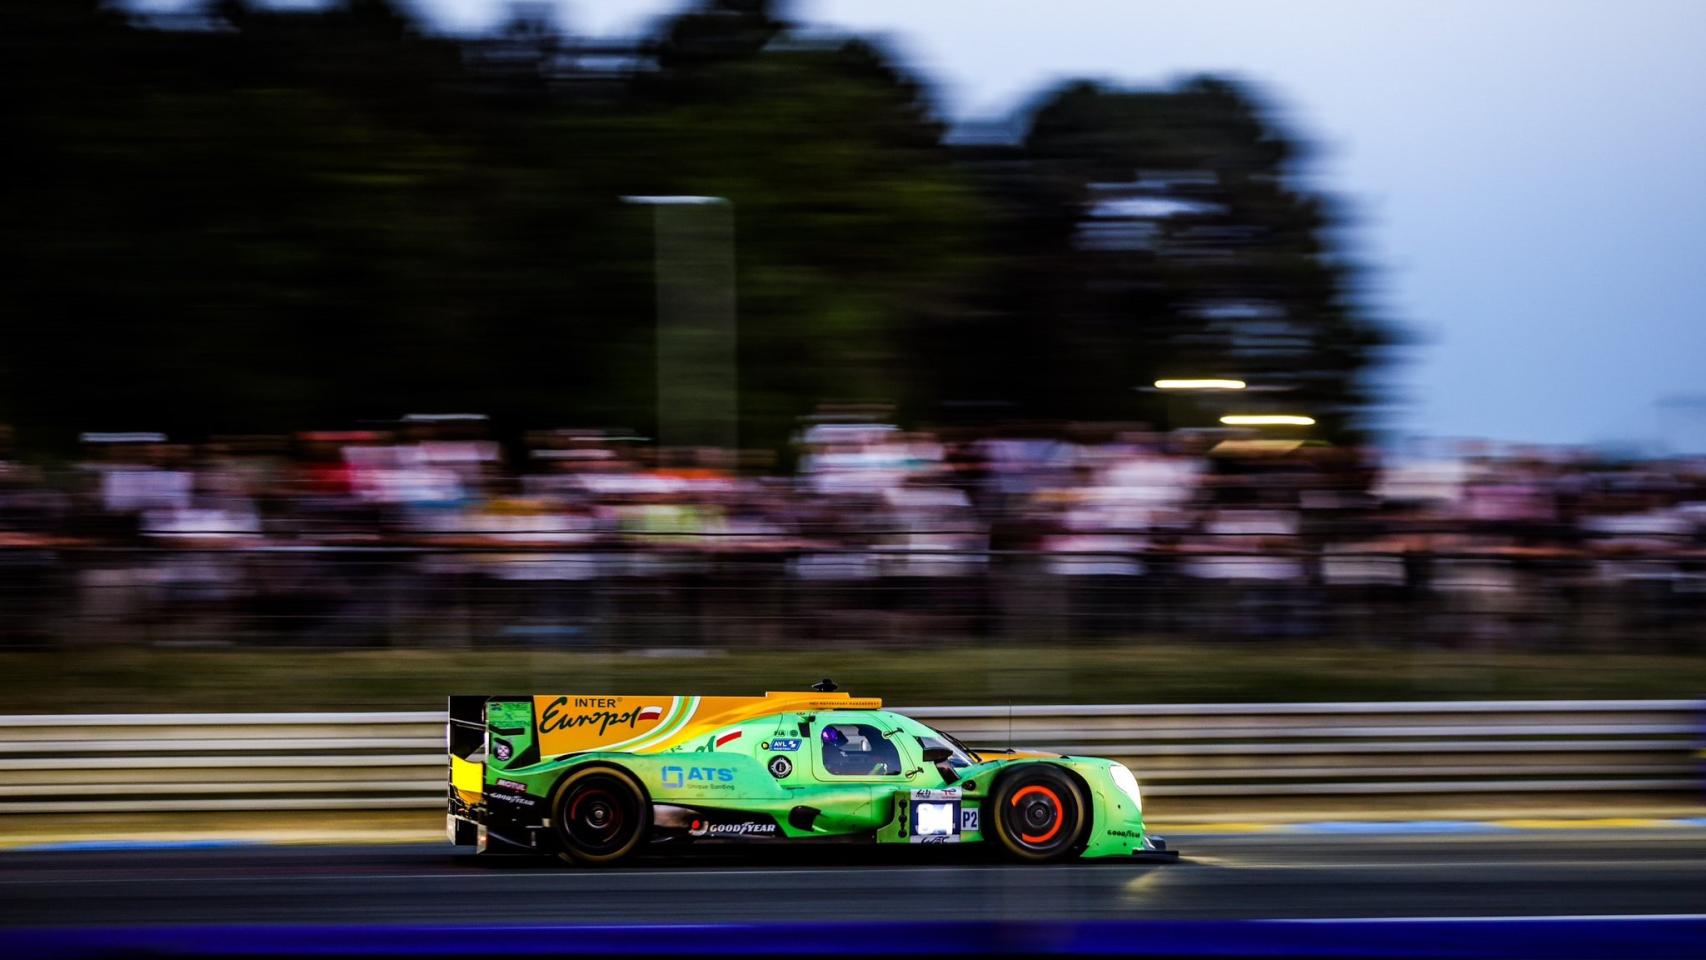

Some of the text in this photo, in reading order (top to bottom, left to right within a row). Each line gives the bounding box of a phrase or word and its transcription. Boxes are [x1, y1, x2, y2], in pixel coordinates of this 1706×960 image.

[575, 698, 616, 708] INTER
[539, 696, 642, 736] Europol
[688, 767, 733, 782] ATS
[962, 811, 978, 828] P2
[709, 821, 776, 835] GOODYEAR
